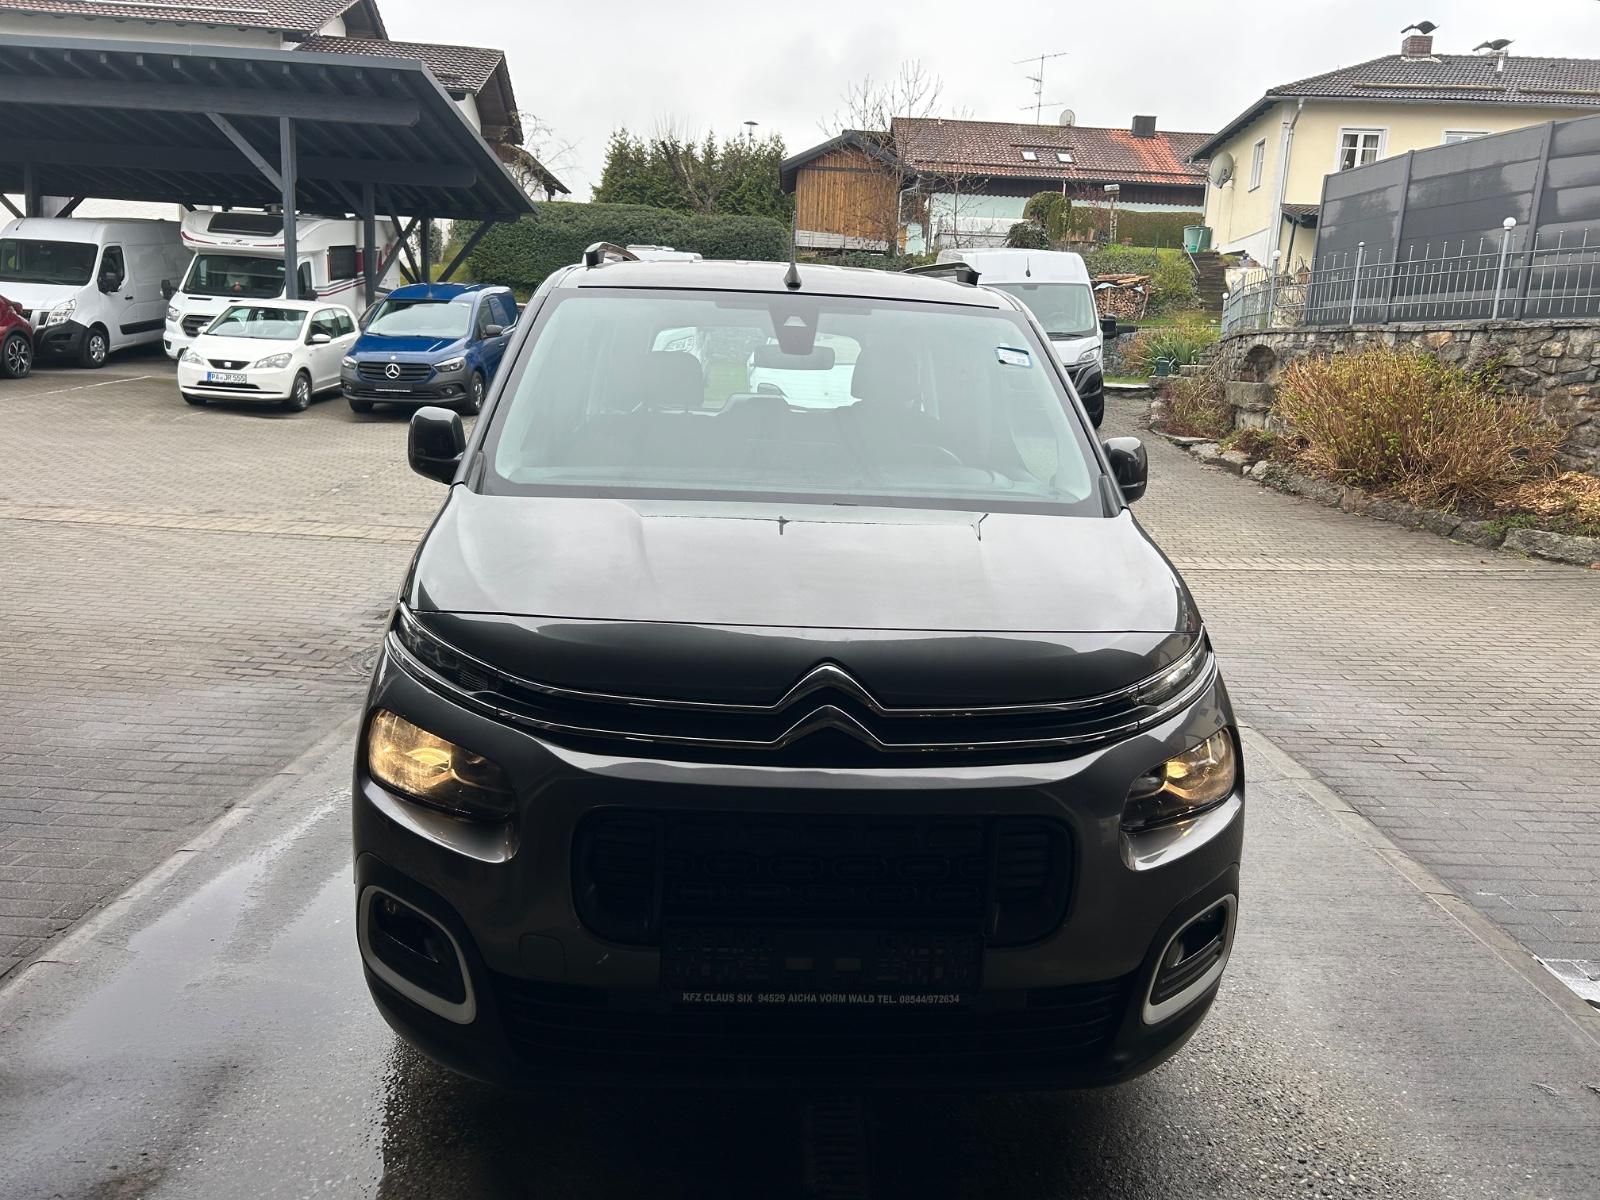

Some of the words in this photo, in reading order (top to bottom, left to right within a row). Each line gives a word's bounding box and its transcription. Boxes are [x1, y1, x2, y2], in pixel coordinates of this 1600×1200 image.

[682, 992, 701, 1002] KFZ
[703, 993, 735, 1002] CLAUS
[736, 993, 753, 1003] SIX
[757, 993, 786, 1003] 94529
[787, 993, 817, 1003] AICHA
[819, 993, 847, 1003] VORM
[848, 993, 876, 1004] WALD
